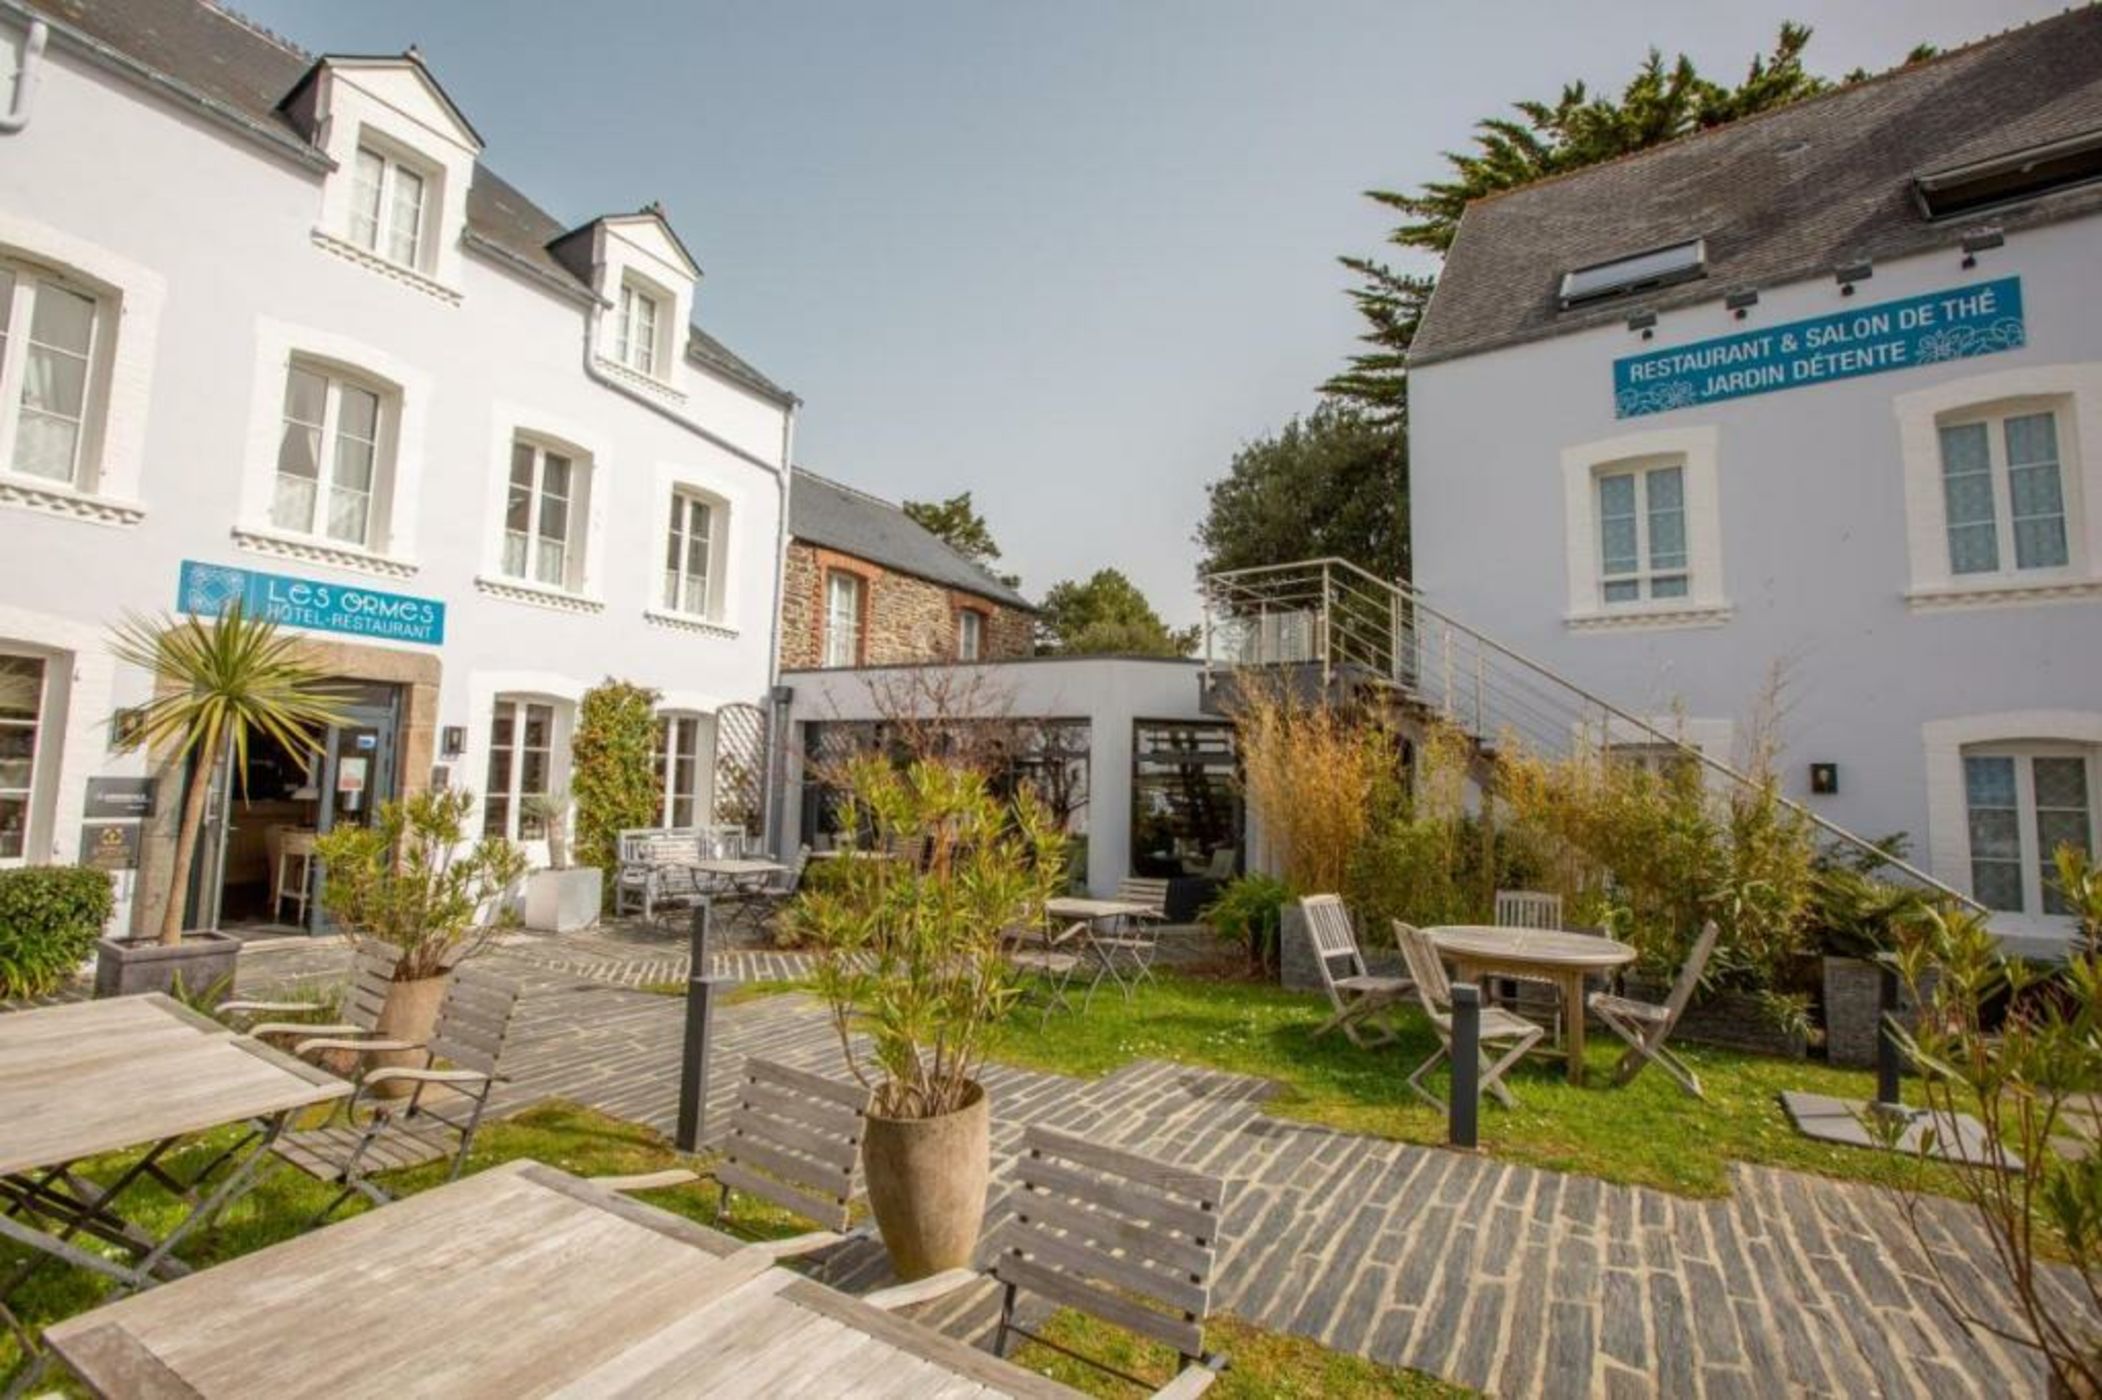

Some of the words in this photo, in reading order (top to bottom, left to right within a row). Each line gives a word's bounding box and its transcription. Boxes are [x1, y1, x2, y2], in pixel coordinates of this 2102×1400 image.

[1630, 337, 1773, 382] RESTAURANT
[1780, 333, 1797, 352] &
[1806, 313, 1889, 348] SALON
[1899, 304, 1936, 329] DE
[1941, 287, 1996, 321] THÉ
[1702, 364, 1785, 397] JARDIN
[1792, 341, 1906, 379] DÉTENTE
